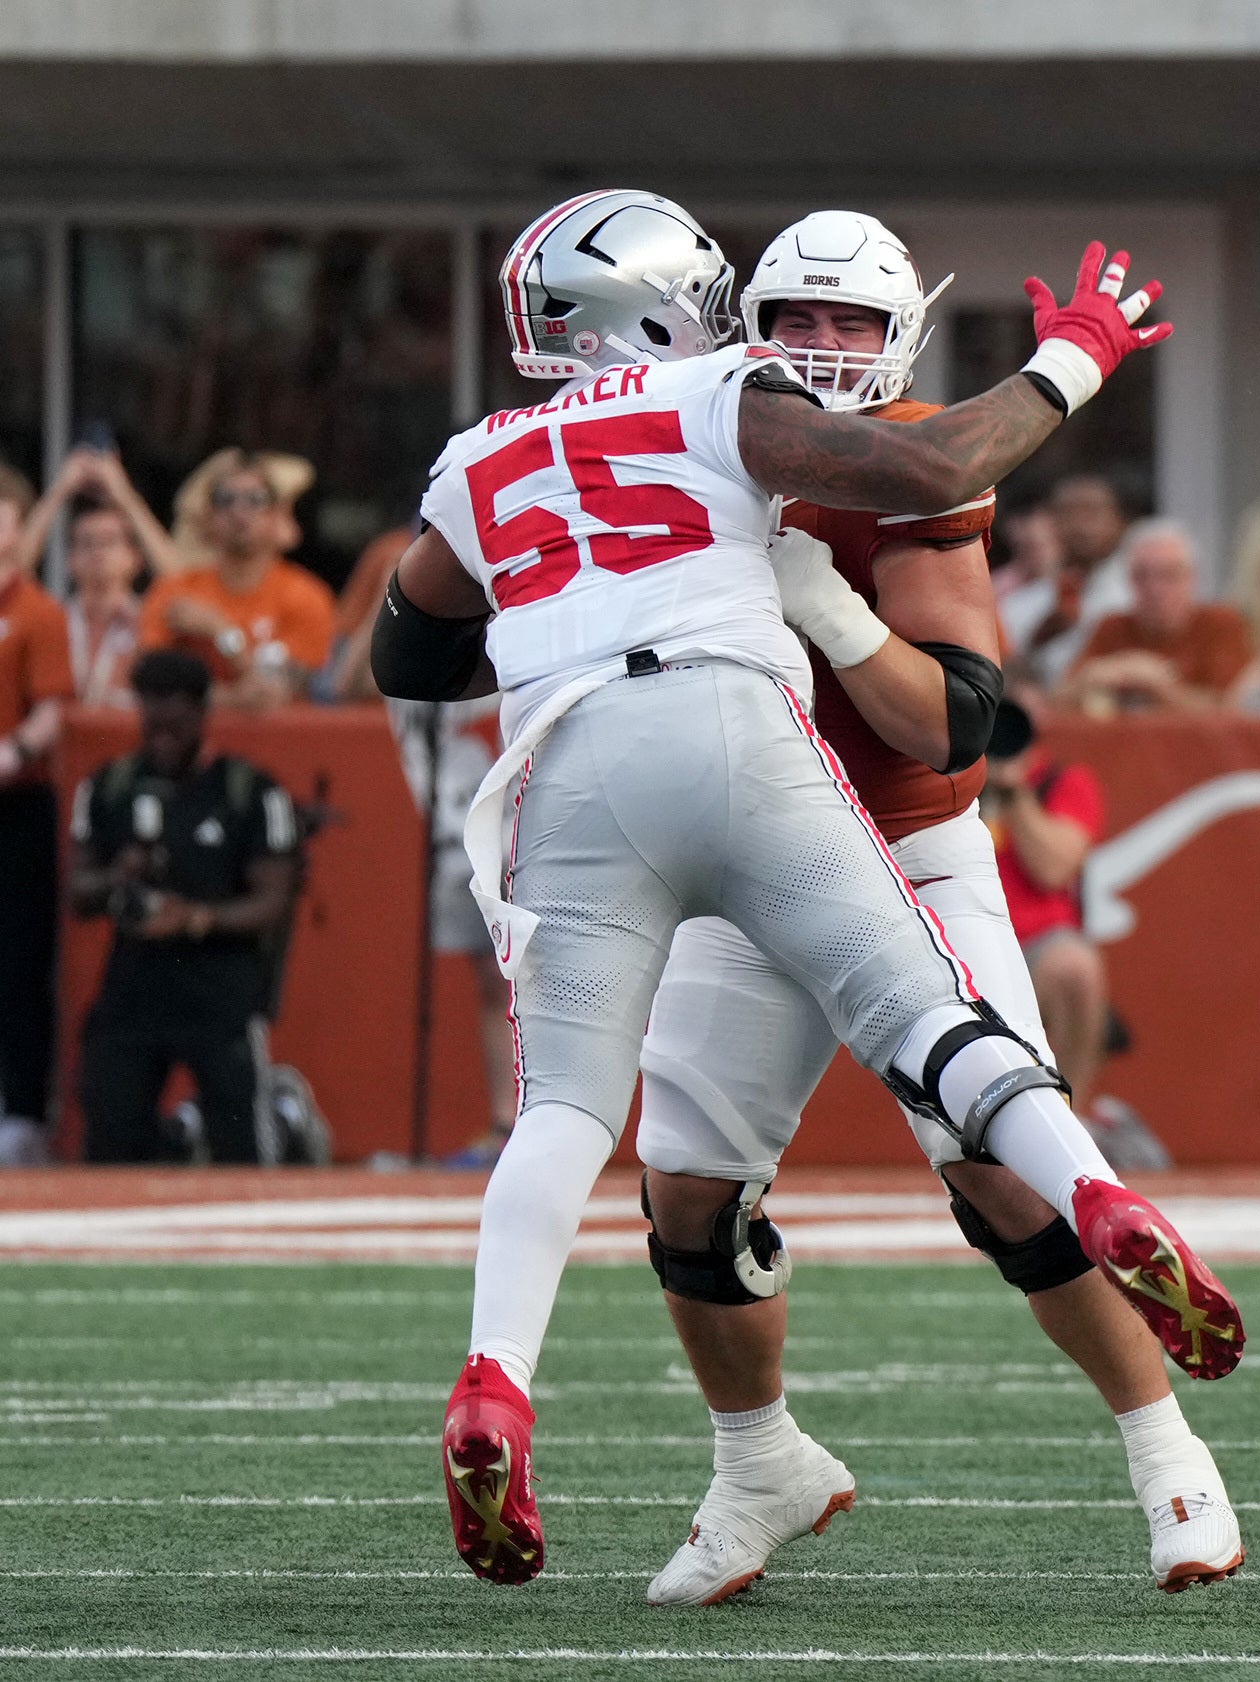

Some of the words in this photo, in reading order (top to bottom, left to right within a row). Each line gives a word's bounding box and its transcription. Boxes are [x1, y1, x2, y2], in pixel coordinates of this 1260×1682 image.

[803, 274, 841, 287] HORNS
[464, 410, 715, 612] 55
[975, 1075, 1019, 1117] DONJOY
